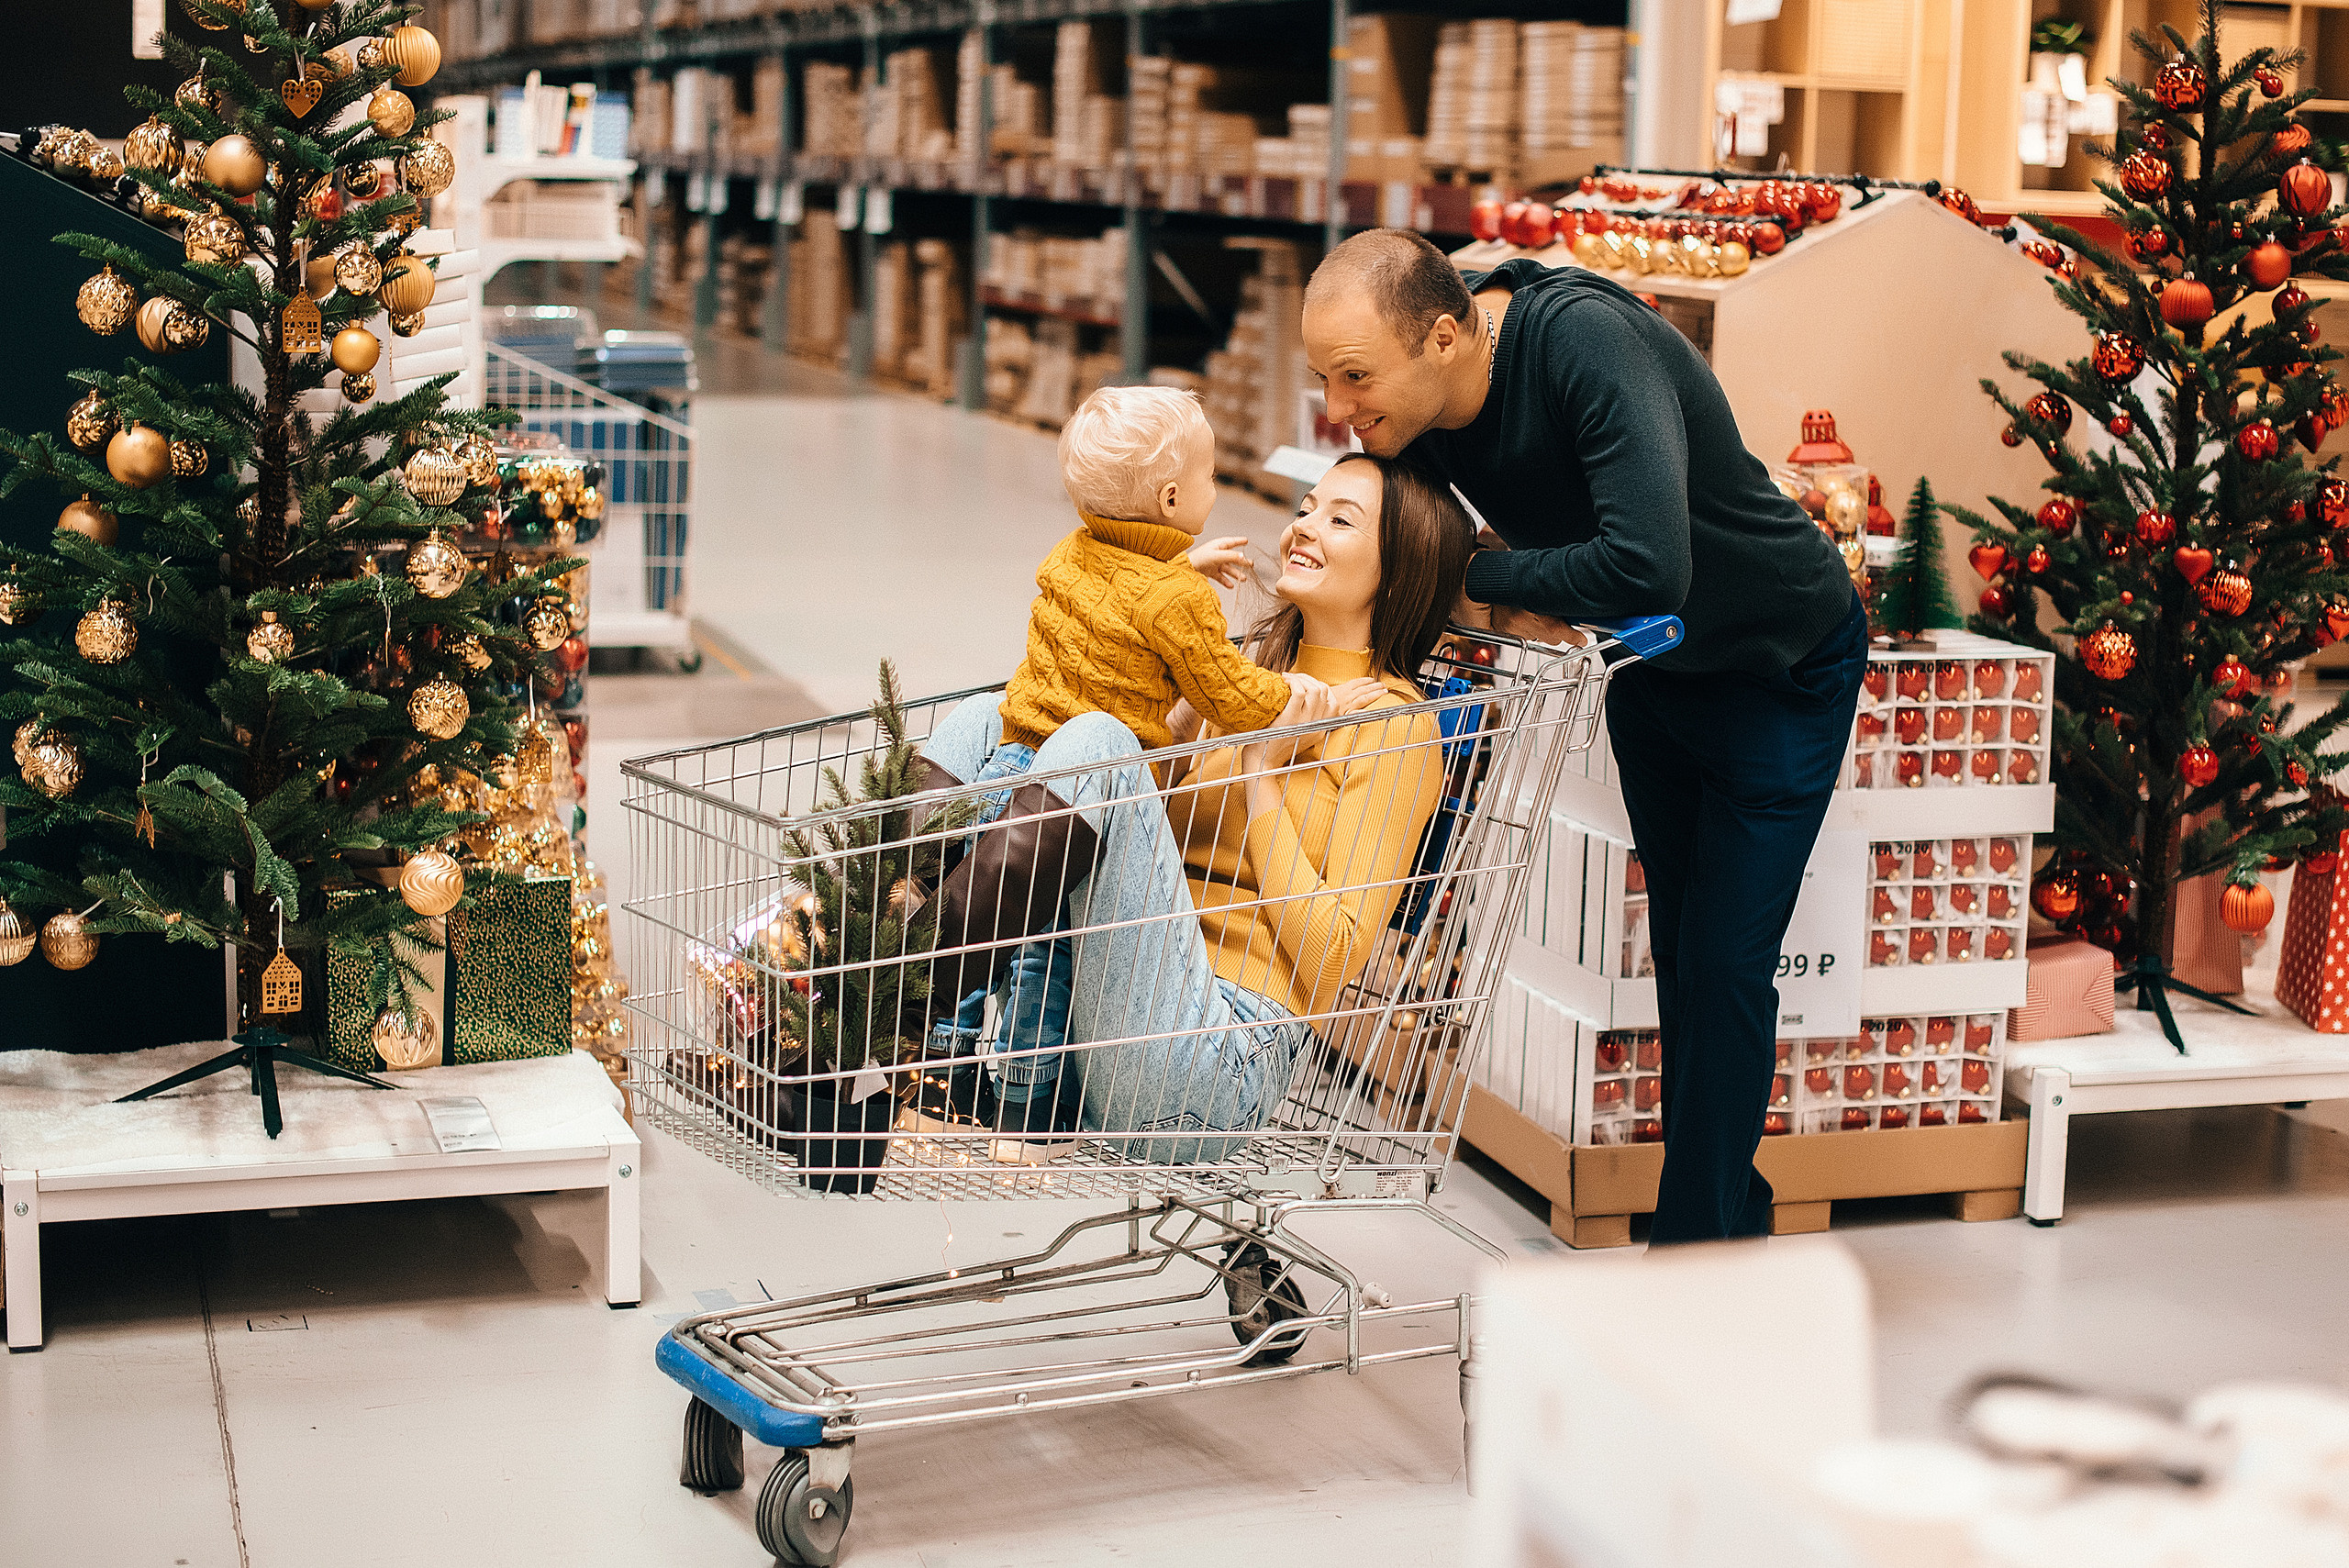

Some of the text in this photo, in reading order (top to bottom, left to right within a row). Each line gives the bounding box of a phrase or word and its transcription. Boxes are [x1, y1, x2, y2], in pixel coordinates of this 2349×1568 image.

[1920, 662, 1952, 673] 2020
[1897, 842, 1929, 854] 2020
[1869, 1020, 1902, 1032] 2020
